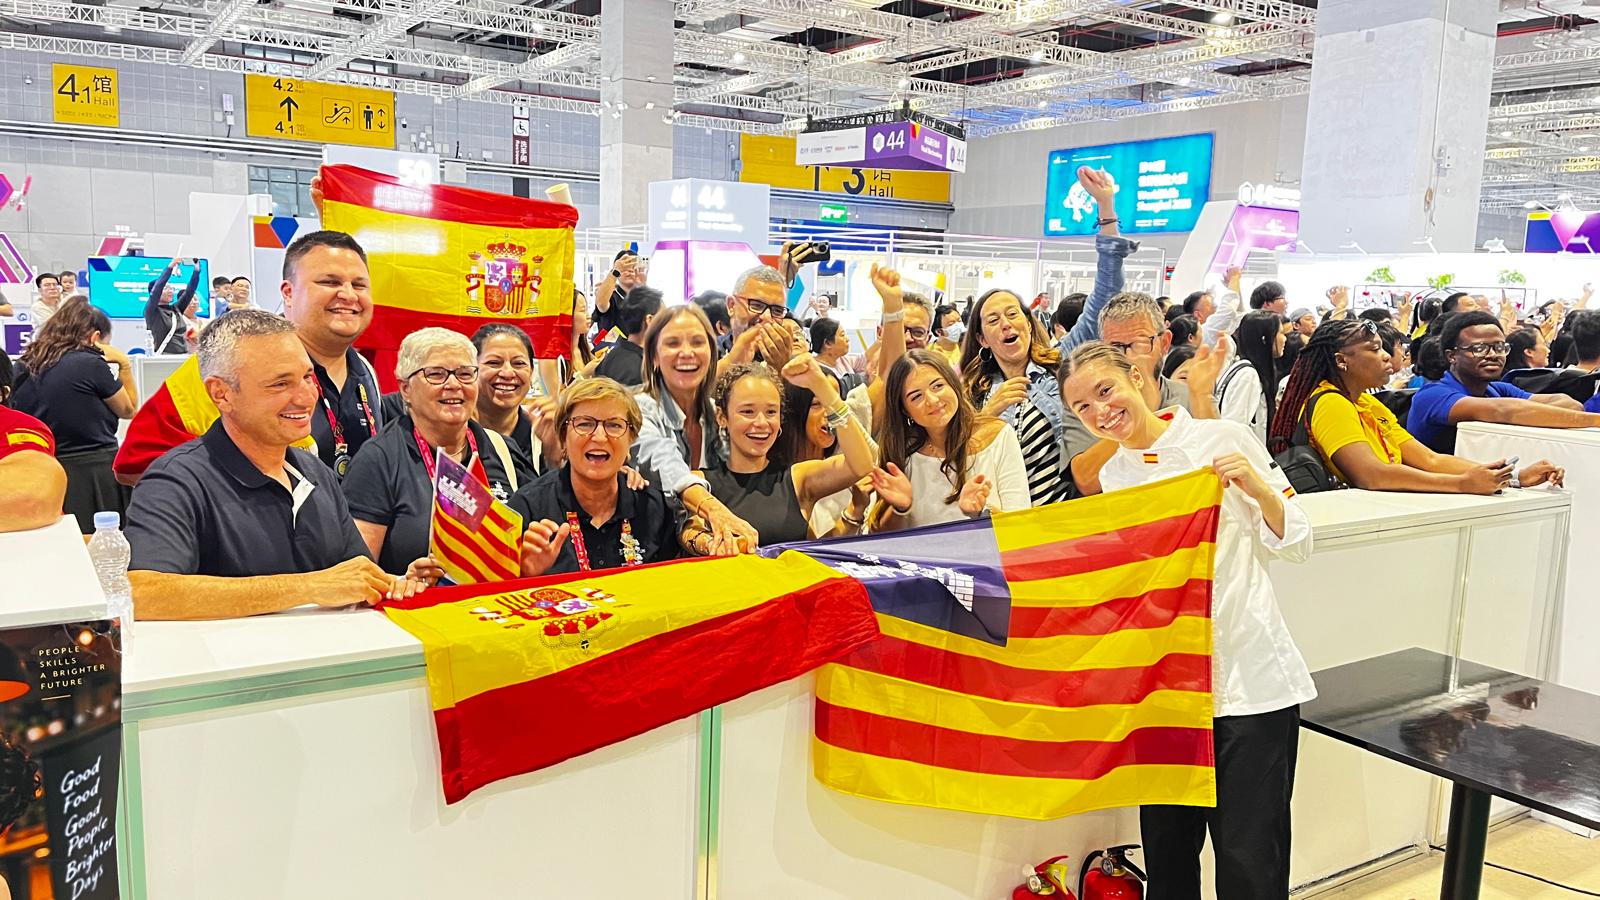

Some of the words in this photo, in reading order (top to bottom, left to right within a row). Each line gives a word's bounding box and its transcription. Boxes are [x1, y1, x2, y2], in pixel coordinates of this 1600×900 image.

[58, 74, 91, 104] 4.1
[93, 75, 112, 94] 馆
[273, 78, 294, 92] 4.2
[94, 97, 115, 107] Hall
[275, 121, 294, 134] 4.1
[886, 129, 905, 150] 44
[956, 147, 965, 162] 44
[398, 158, 432, 187] 50
[843, 168, 865, 195] 3
[697, 184, 726, 210] 44
[869, 185, 894, 198] Hall
[38, 645, 80, 657] PEOPLE
[39, 657, 77, 668] SKILLS
[52, 663, 105, 678] BRIGHTER
[40, 678, 83, 690] FUTURE
[60, 755, 102, 794] Good
[63, 776, 101, 815] Food
[65, 797, 102, 836] Good
[68, 816, 108, 857] People
[65, 835, 115, 883] Brighter
[71, 864, 104, 900] Days
